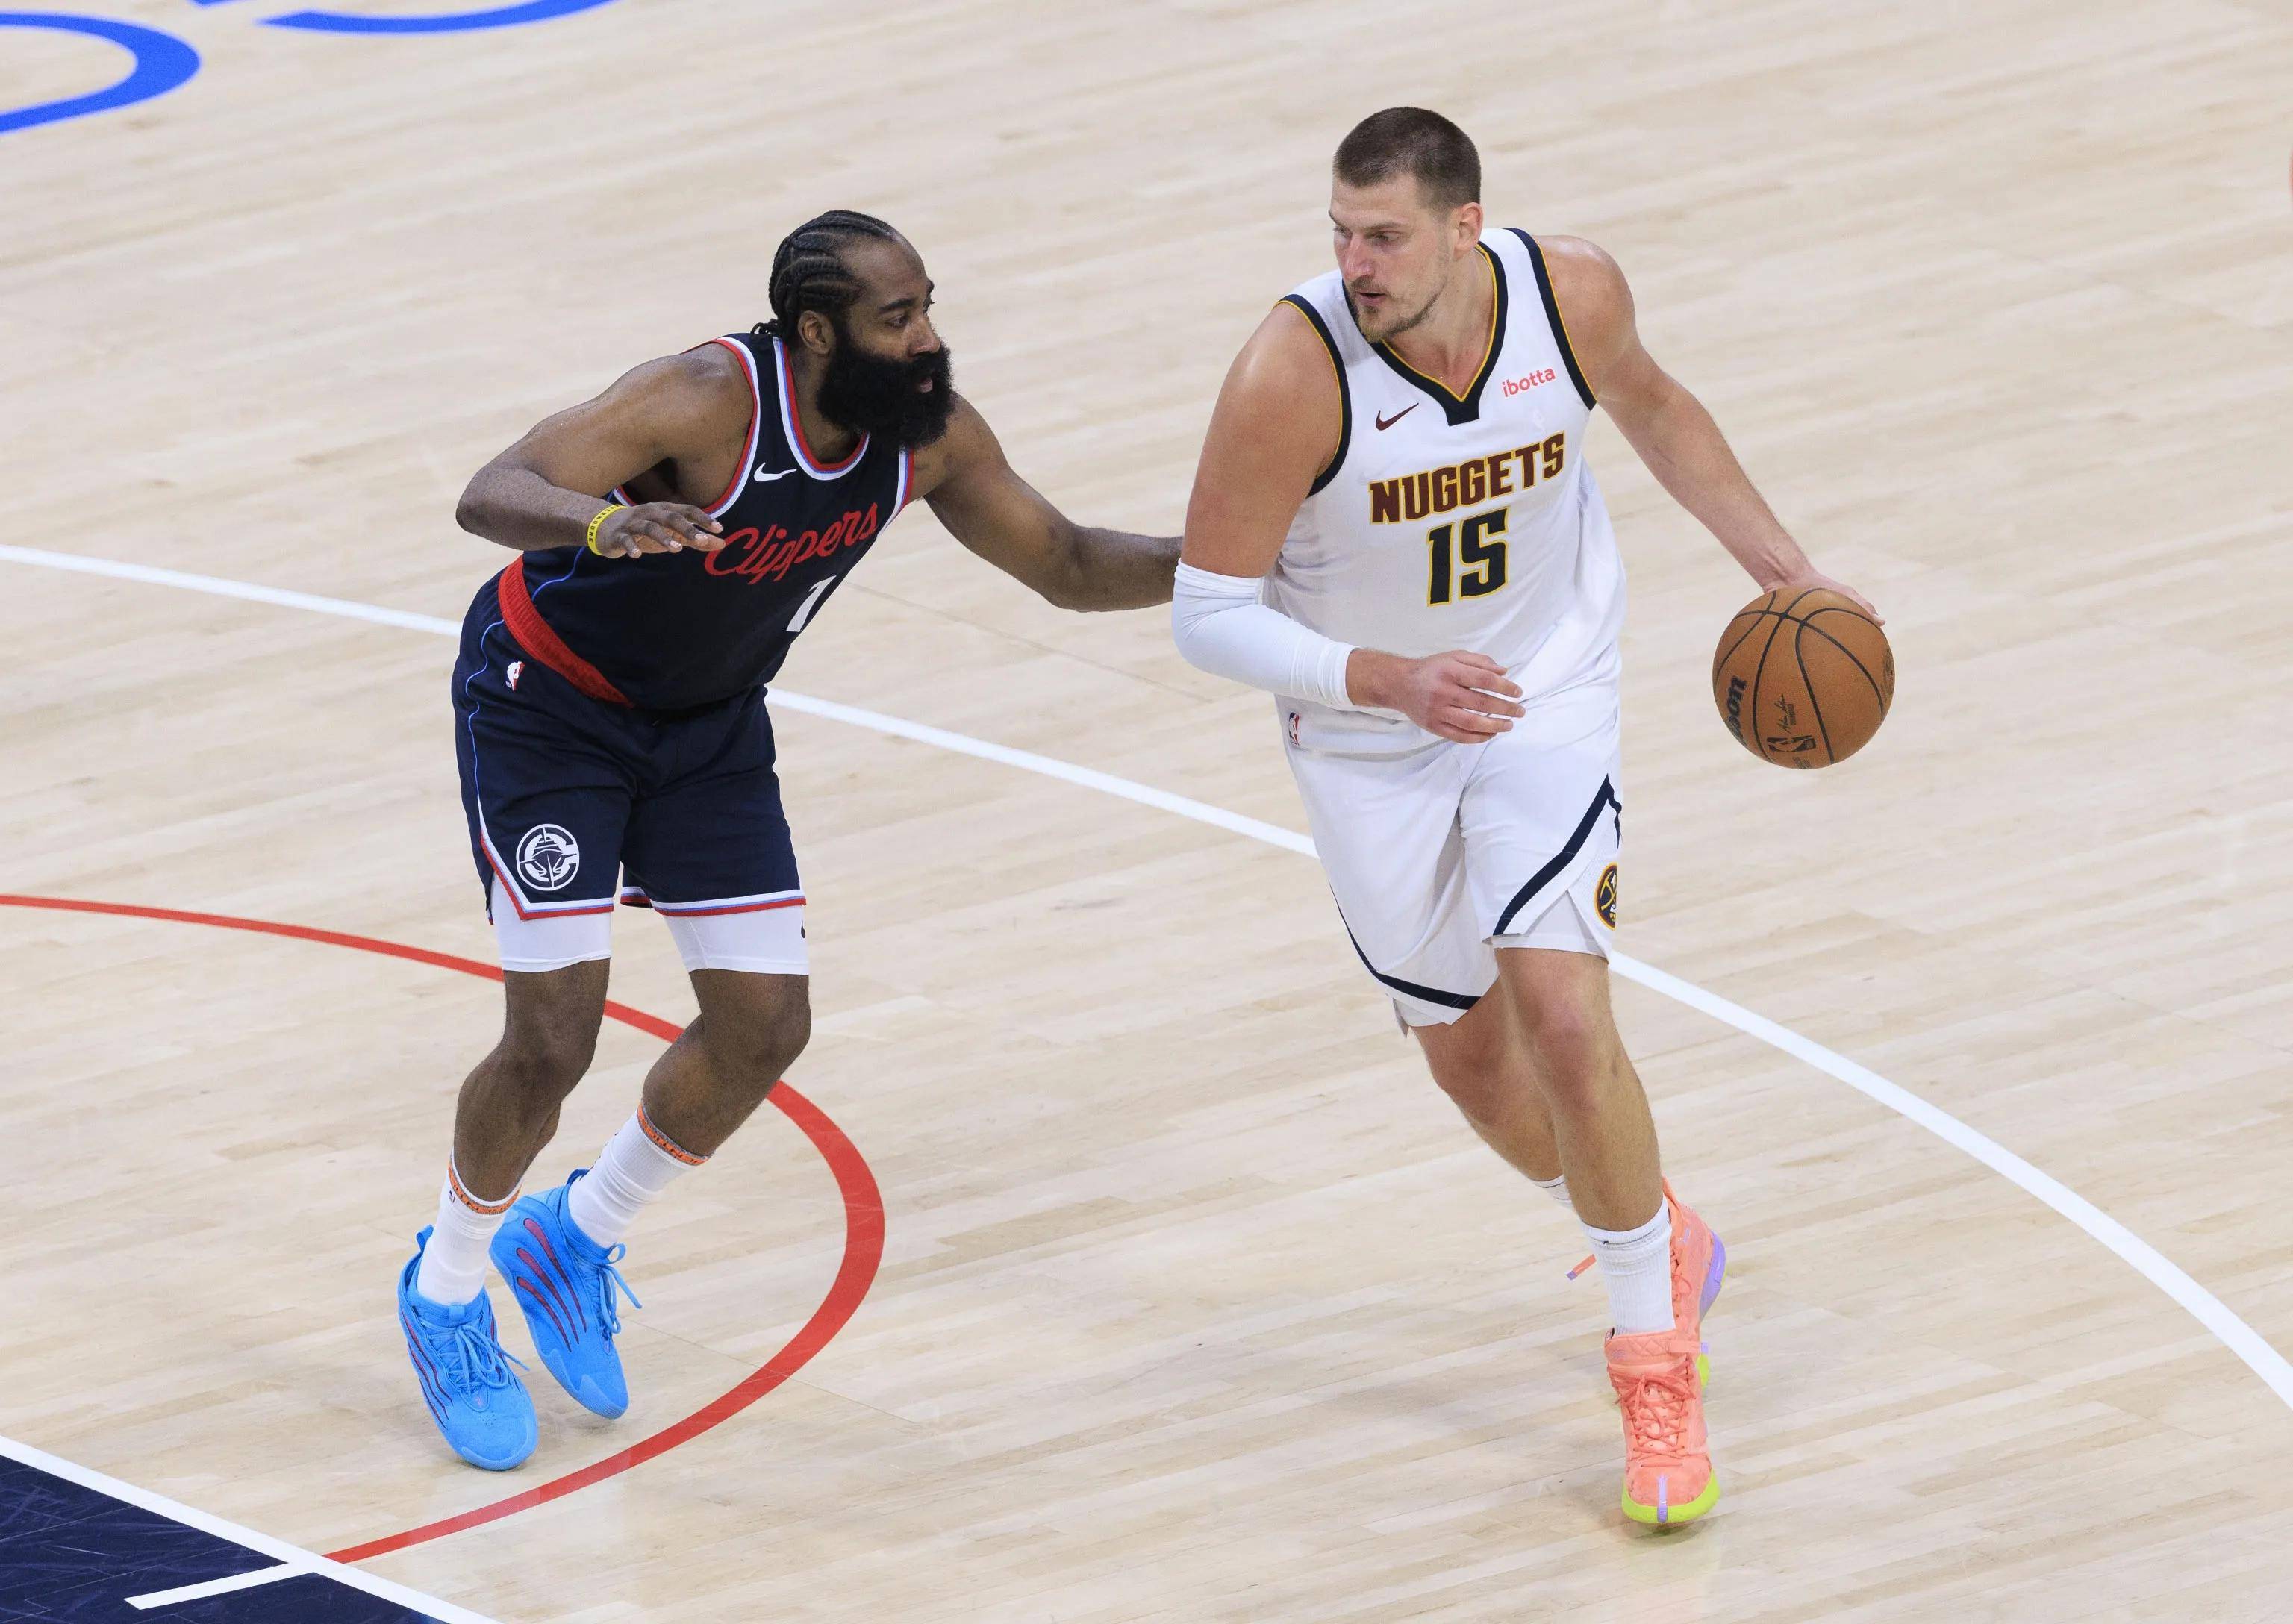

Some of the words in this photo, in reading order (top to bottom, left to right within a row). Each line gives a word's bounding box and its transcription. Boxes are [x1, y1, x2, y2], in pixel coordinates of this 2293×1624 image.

[1502, 368, 1556, 398] ibotta
[1369, 430, 1564, 525] NUGGETS
[704, 502, 878, 585] Clippers
[1426, 507, 1509, 607] 15
[786, 574, 837, 632] 1
